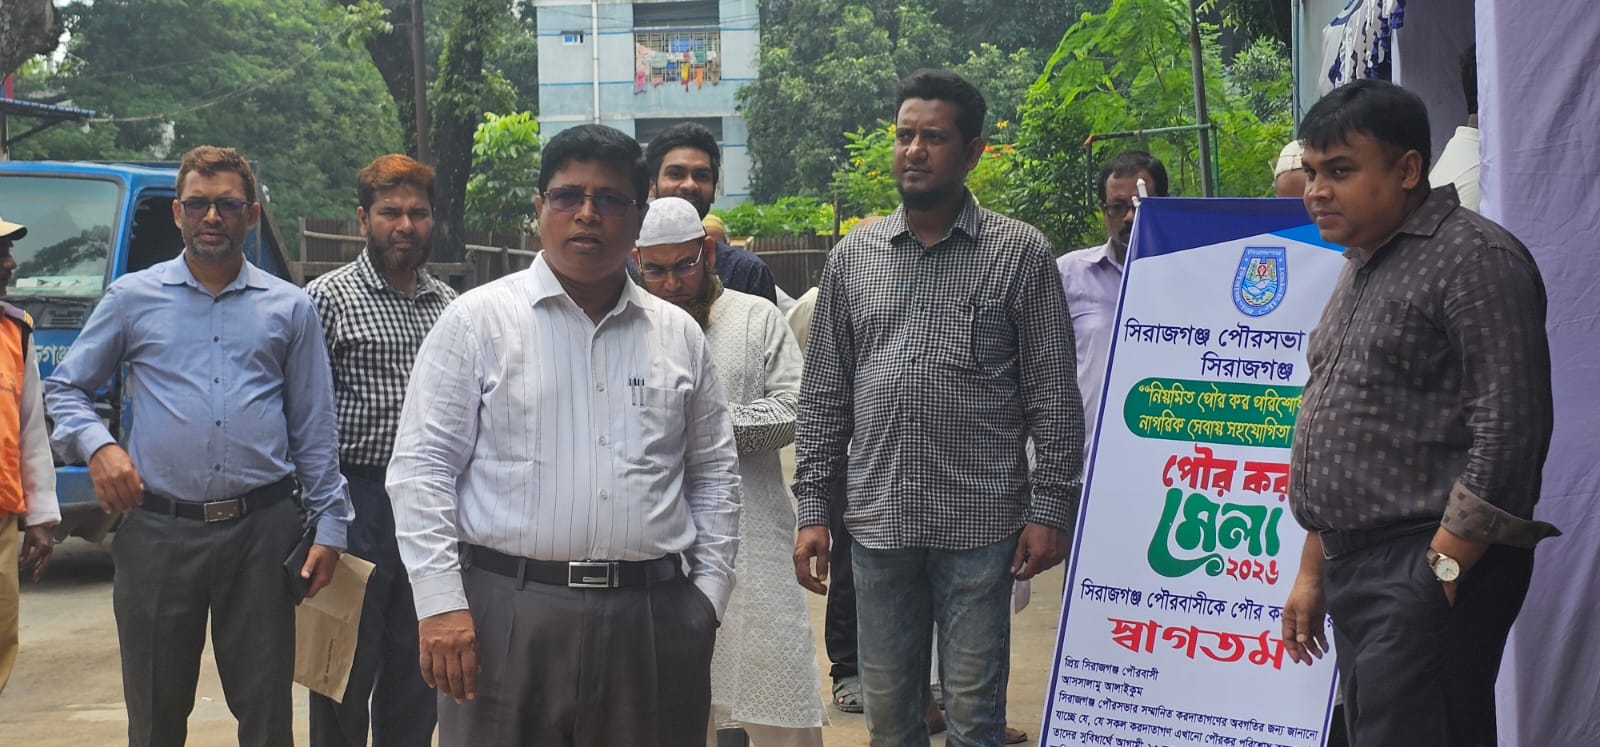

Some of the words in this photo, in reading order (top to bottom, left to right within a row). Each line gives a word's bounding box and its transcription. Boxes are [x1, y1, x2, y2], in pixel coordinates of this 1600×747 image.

[1123, 317, 1210, 347] সিরাজগঞ্জ
[1218, 322, 1306, 352] পৌরসভা
[1200, 350, 1294, 382] সিরাজগঞ্জ
[1198, 383, 1225, 413] পৌর
[1228, 393, 1251, 410] কর
[1139, 409, 1186, 435] নাগরিক
[1187, 418, 1225, 439] সেবায়
[1227, 417, 1292, 444] সহযোগিতা
[1162, 443, 1238, 497] পৌর
[1242, 461, 1290, 503] কর
[1147, 487, 1283, 578] মেলা
[1226, 556, 1279, 585] ২০২৬
[1080, 578, 1142, 607] সিরাজগঞ্জ
[1147, 589, 1227, 617] পৌরবাসীকে
[1231, 598, 1264, 622] পৌর
[1268, 605, 1284, 622] ক
[1107, 617, 1285, 670] স্বাগতম
[1065, 656, 1079, 669] প্রিয়
[1082, 658, 1119, 675] সিরাজগঞ্জ
[1122, 664, 1159, 680] পৌরবাসী
[1062, 675, 1102, 691] আসসালামু
[1104, 681, 1144, 698] আলাইকুম
[1059, 690, 1095, 706] সিরাজগঞ্জ
[1098, 697, 1138, 713] পৌরসভার
[1230, 718, 1265, 732] অবগতির
